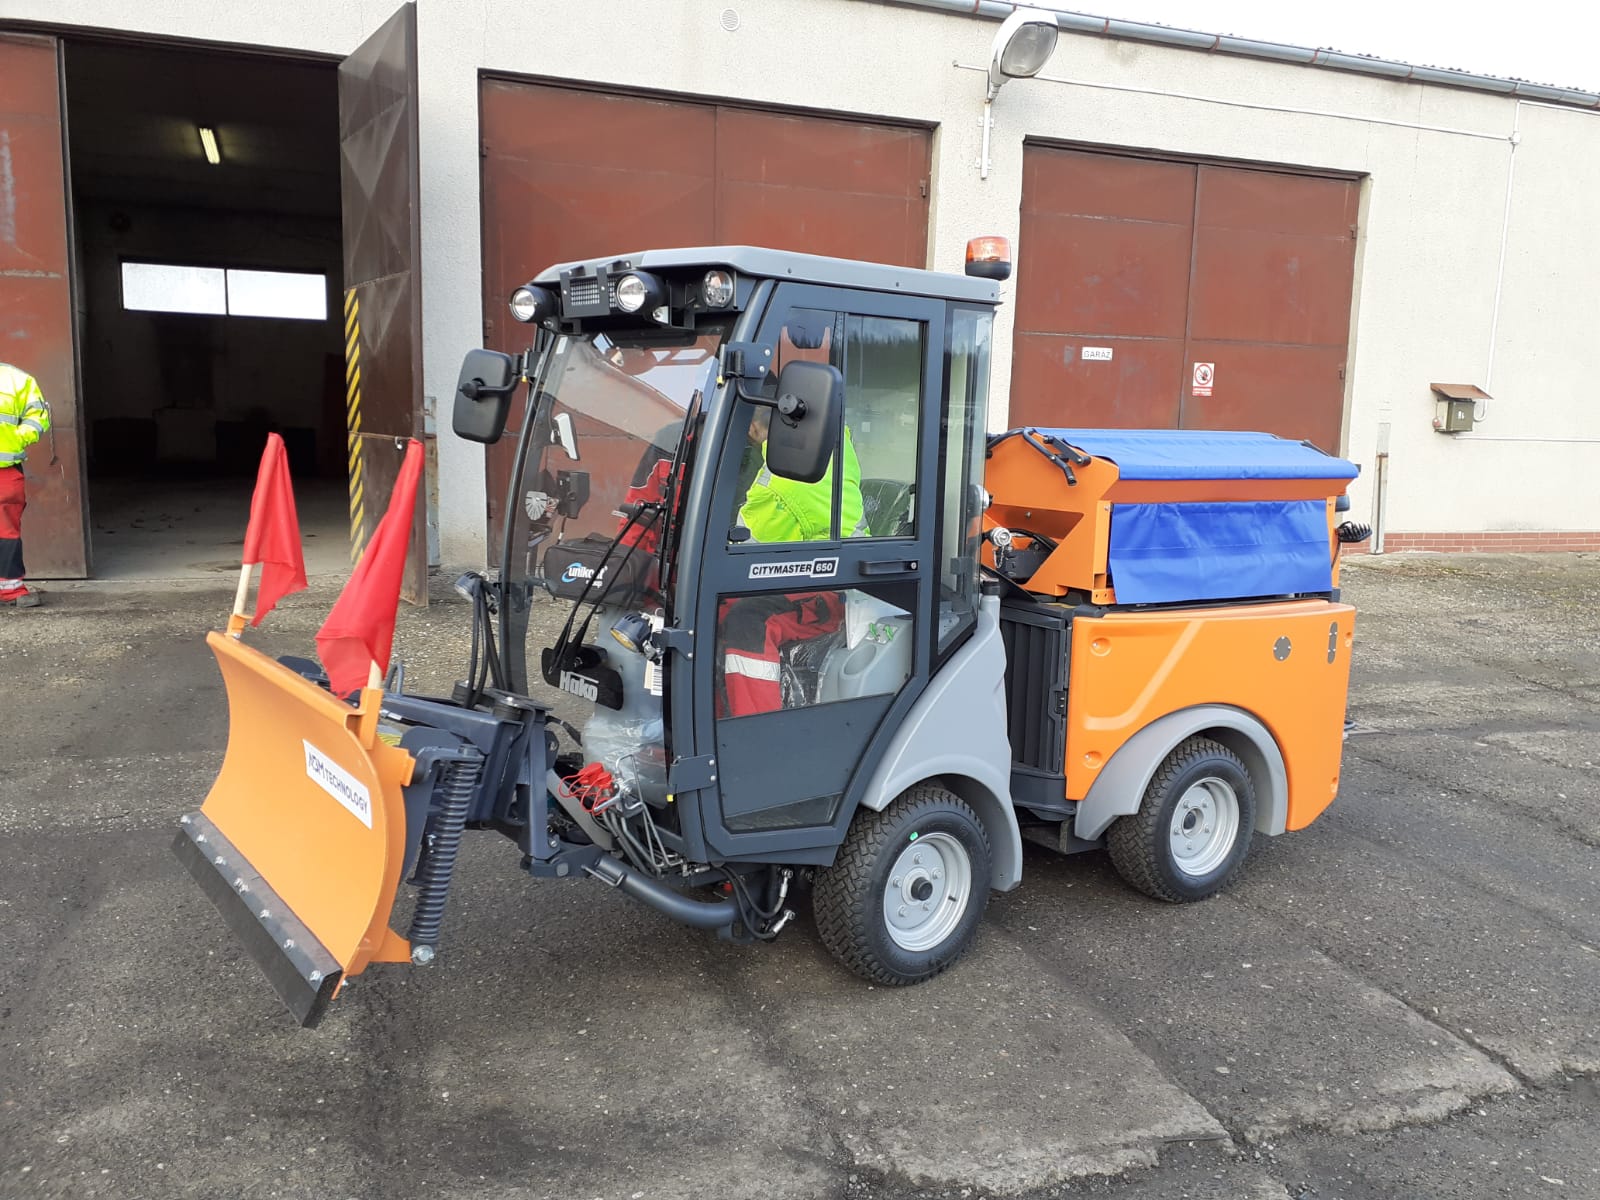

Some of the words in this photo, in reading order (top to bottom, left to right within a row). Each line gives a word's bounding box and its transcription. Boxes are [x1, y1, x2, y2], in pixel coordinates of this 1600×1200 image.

[752, 562, 812, 576] CITYMASTER
[815, 561, 833, 573] 650
[559, 670, 599, 702] Hako
